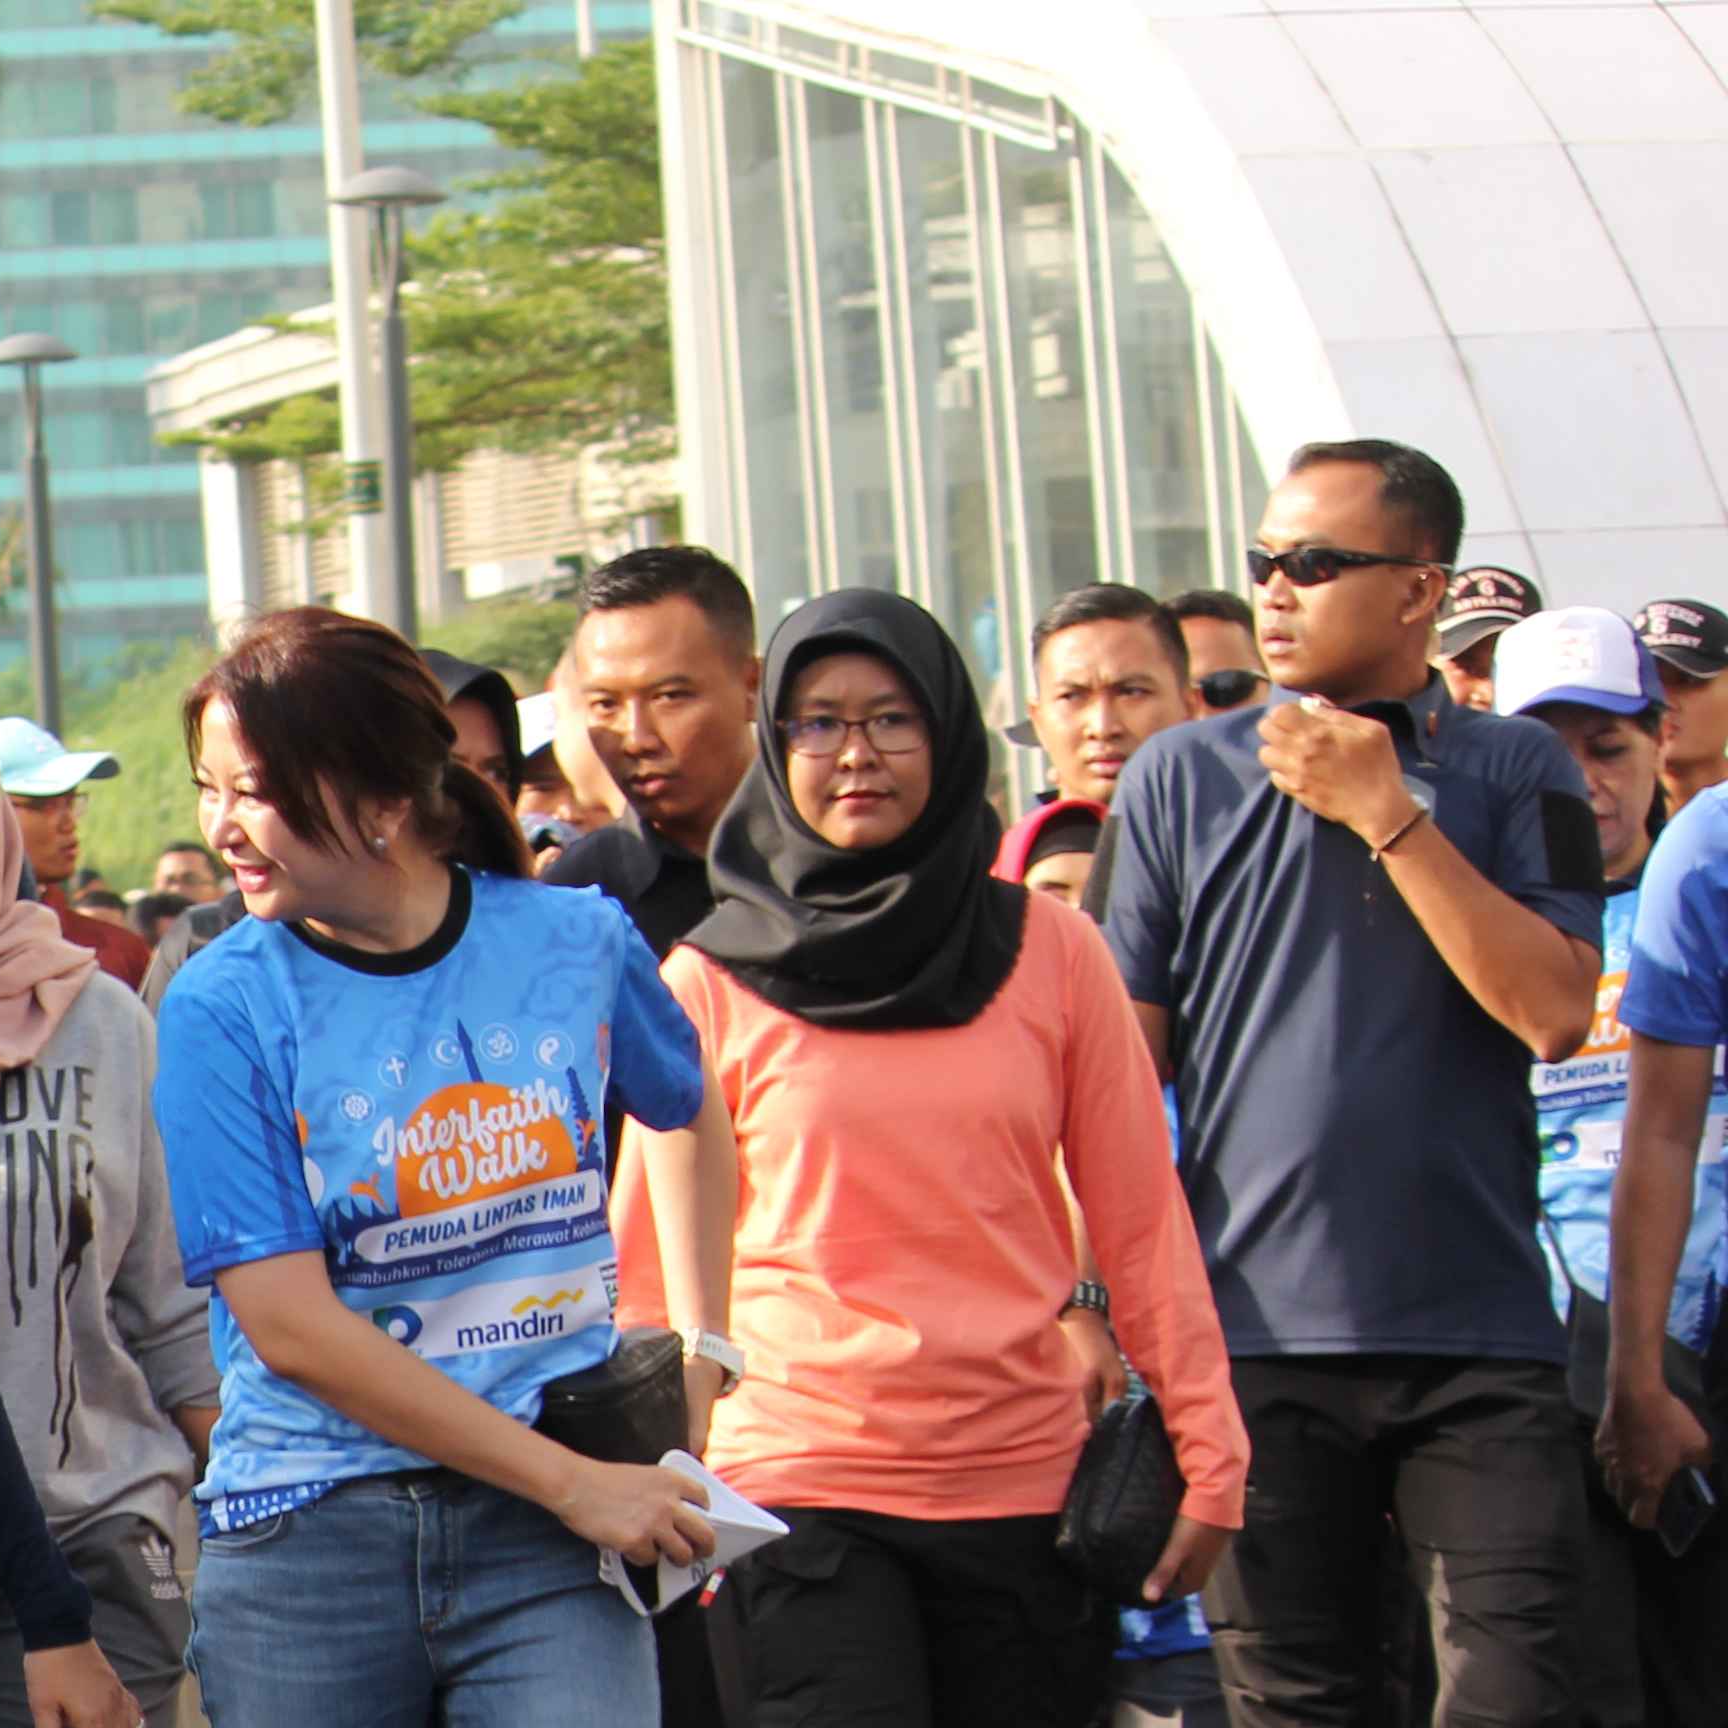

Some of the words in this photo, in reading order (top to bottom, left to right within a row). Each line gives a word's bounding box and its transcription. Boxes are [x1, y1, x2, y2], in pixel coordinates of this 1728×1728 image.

[1545, 1061, 1610, 1085] PEMUDA
[373, 1078, 569, 1166] Interfaith
[419, 1132, 548, 1199] Walk
[384, 1218, 467, 1253] PEMUDA
[472, 1194, 536, 1233] LINTAS
[542, 1183, 586, 1210] IMAN
[502, 1228, 570, 1252] Merawat
[456, 1311, 564, 1348] mandiri
